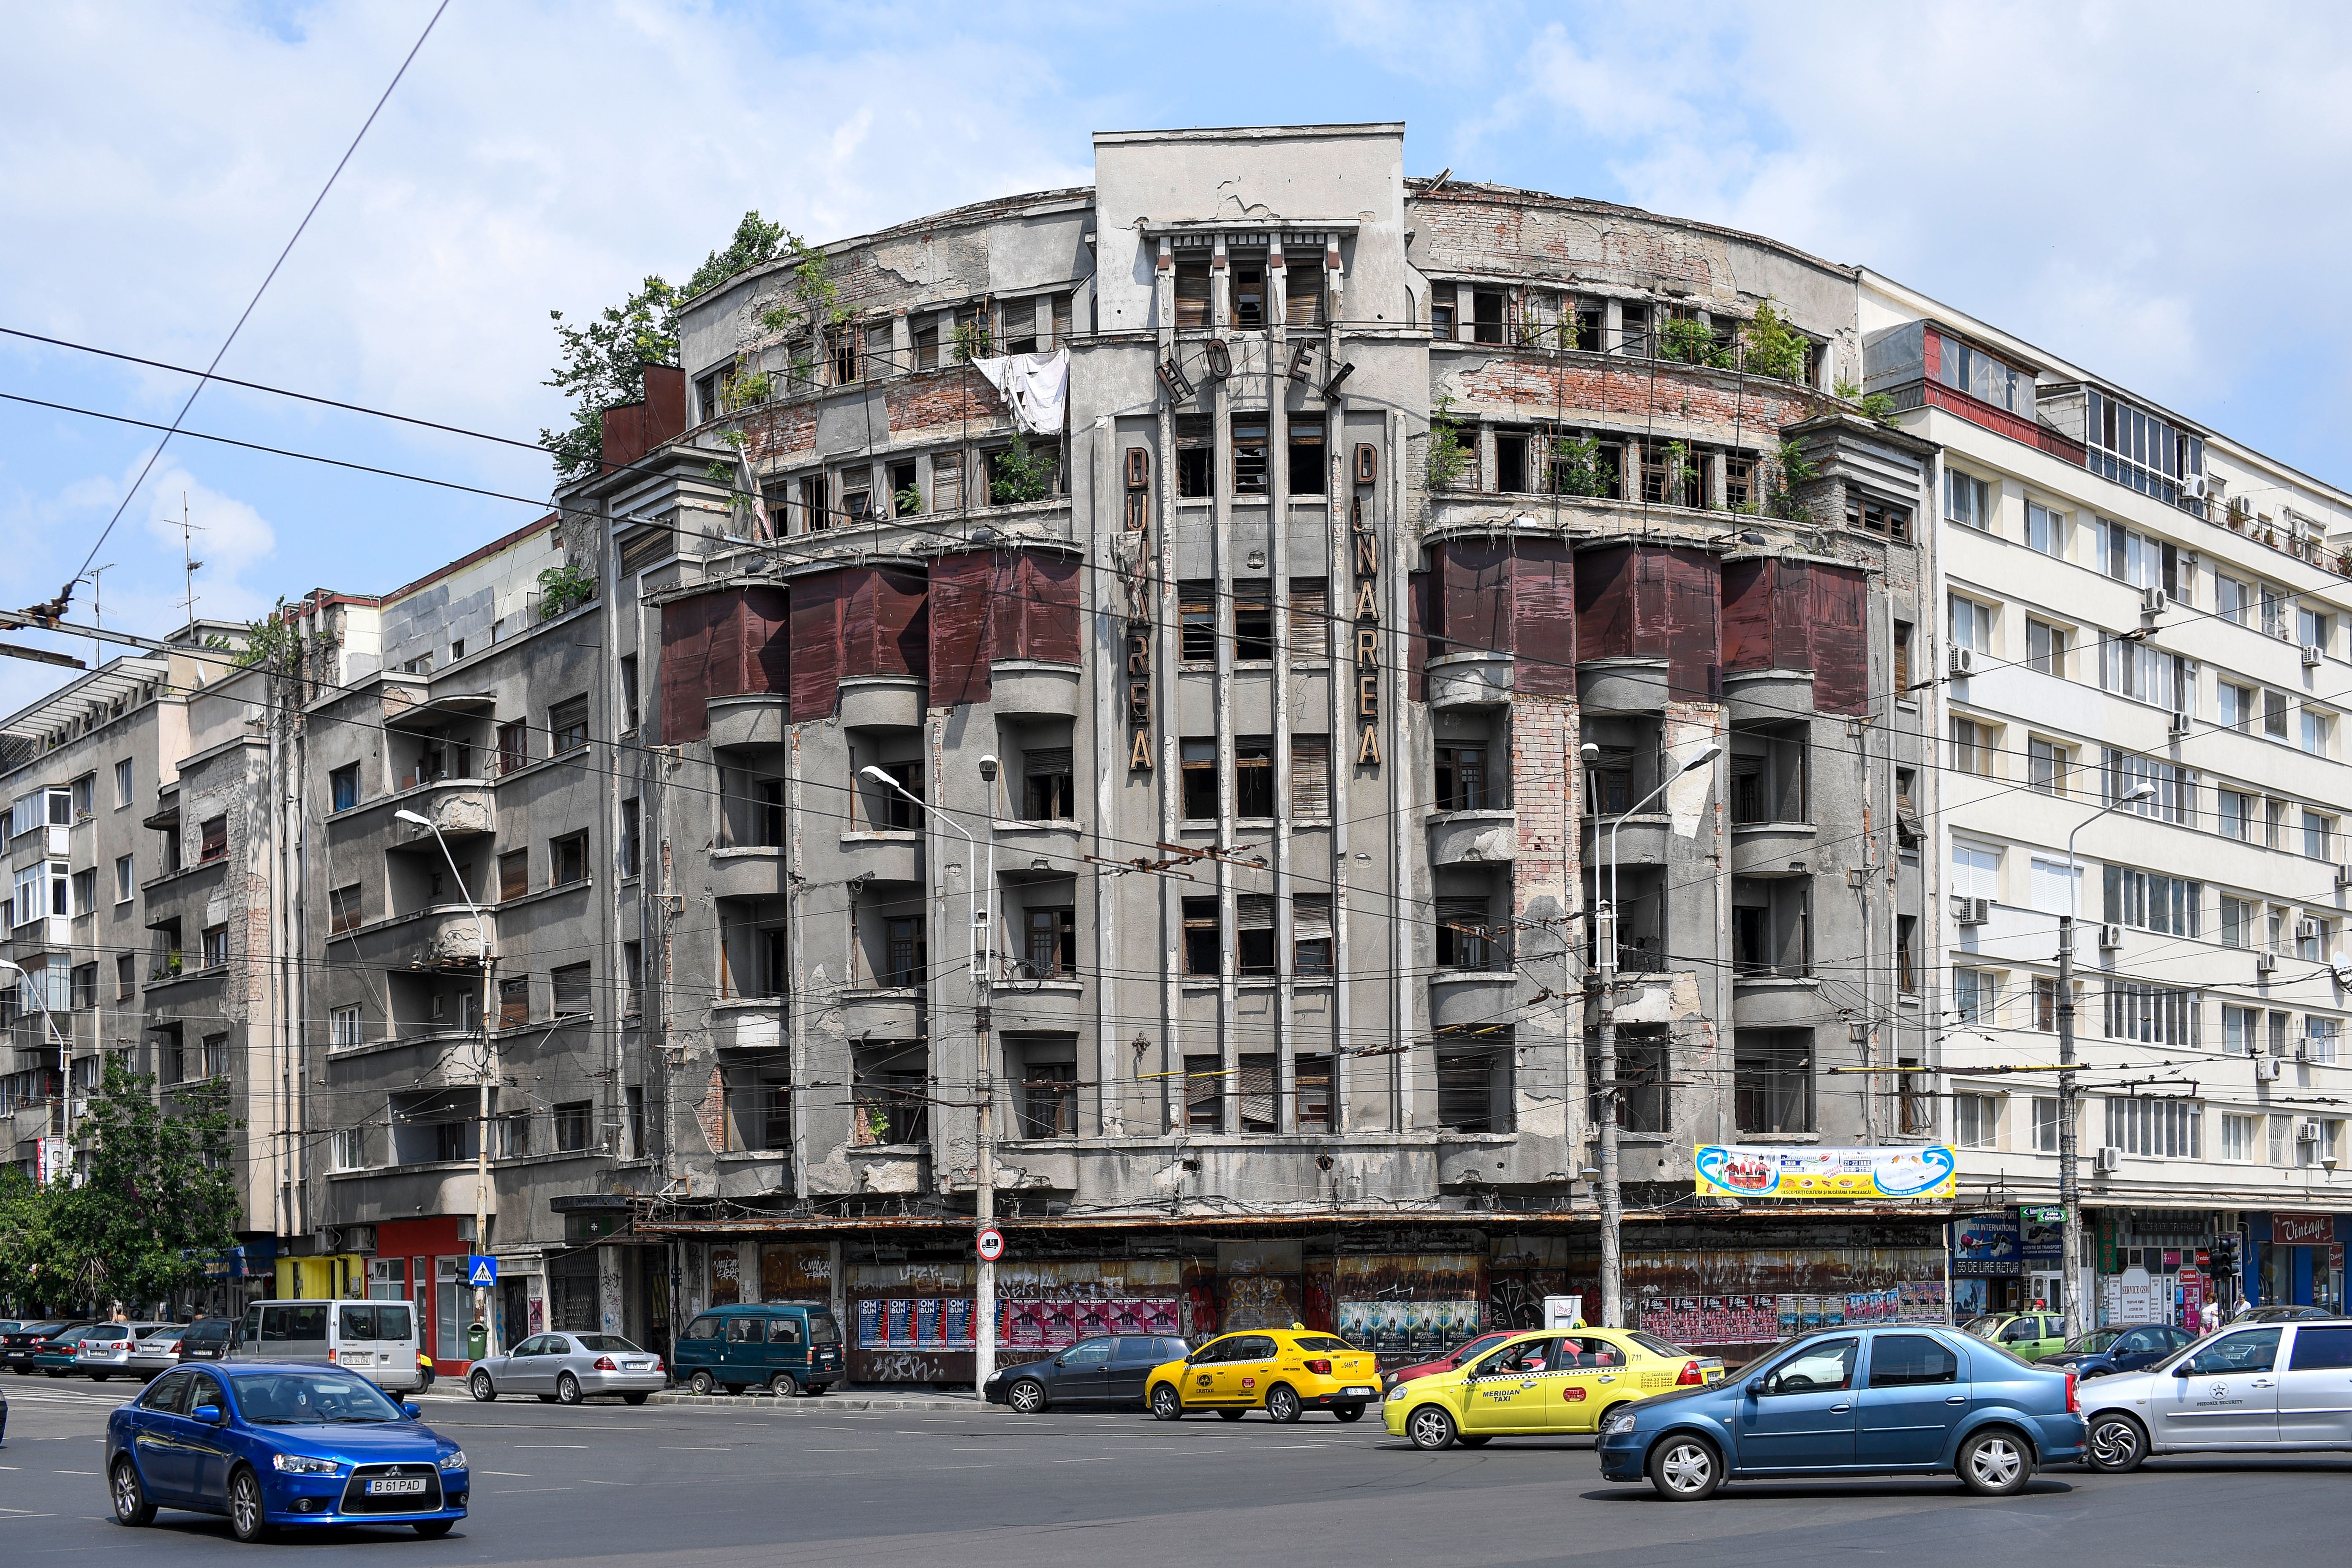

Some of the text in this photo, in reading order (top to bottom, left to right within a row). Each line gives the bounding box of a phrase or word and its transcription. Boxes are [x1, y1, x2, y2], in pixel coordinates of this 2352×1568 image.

[1822, 1165, 1843, 1176] INTRAREA
[1989, 1210, 2017, 1220] TRANSPORT
[1981, 1224, 2017, 1232] INTERNATIONAL
[2103, 1220, 2112, 1240] NON
[2282, 1218, 2325, 1241] Vintage
[2103, 1243, 2112, 1270] STOP
[1957, 1262, 2019, 1273] 55 DE LIRE RETUR
[2122, 1285, 2149, 1294] SERVICE GSM
[1483, 1389, 1520, 1397] MERIDIAN
[375, 1480, 420, 1491] B 61 PAD
